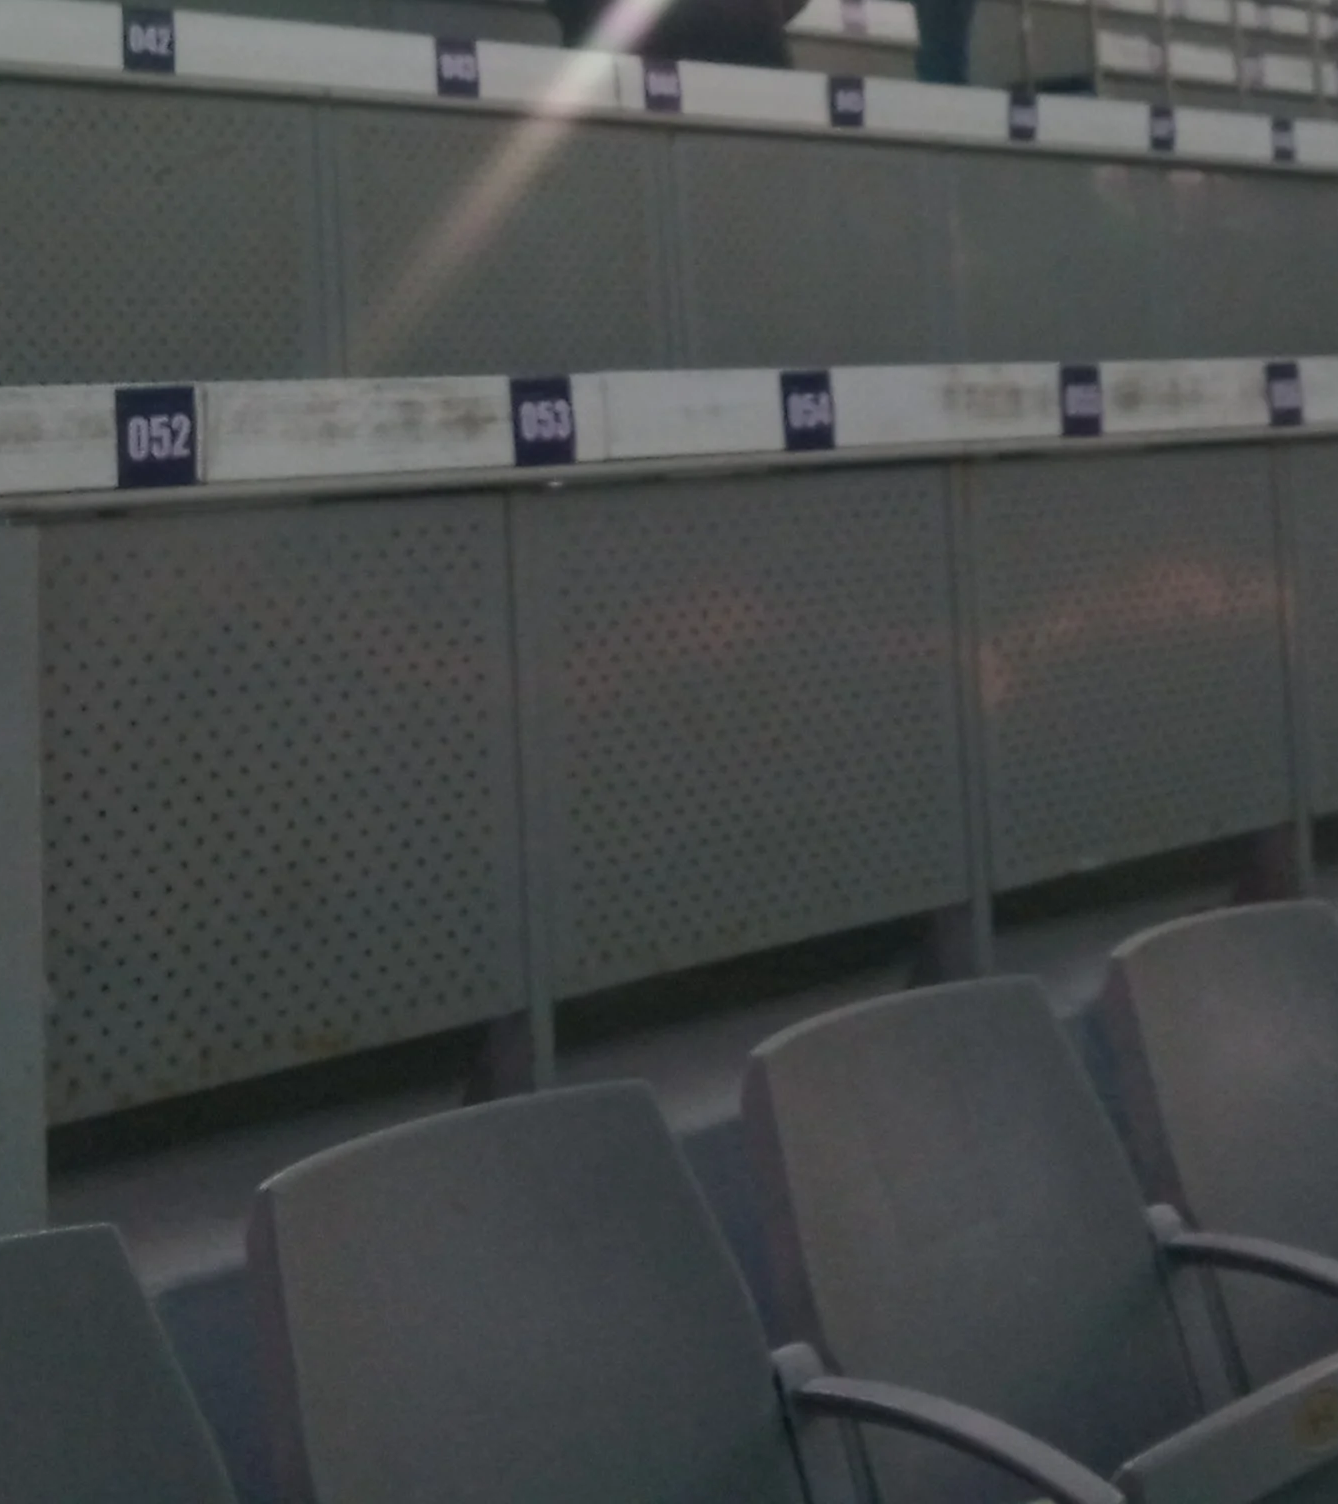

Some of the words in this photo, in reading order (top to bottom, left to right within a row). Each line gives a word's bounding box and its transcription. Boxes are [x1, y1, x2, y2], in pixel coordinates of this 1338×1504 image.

[128, 23, 172, 56] 042
[128, 413, 191, 462] 052
[519, 398, 572, 441] 053
